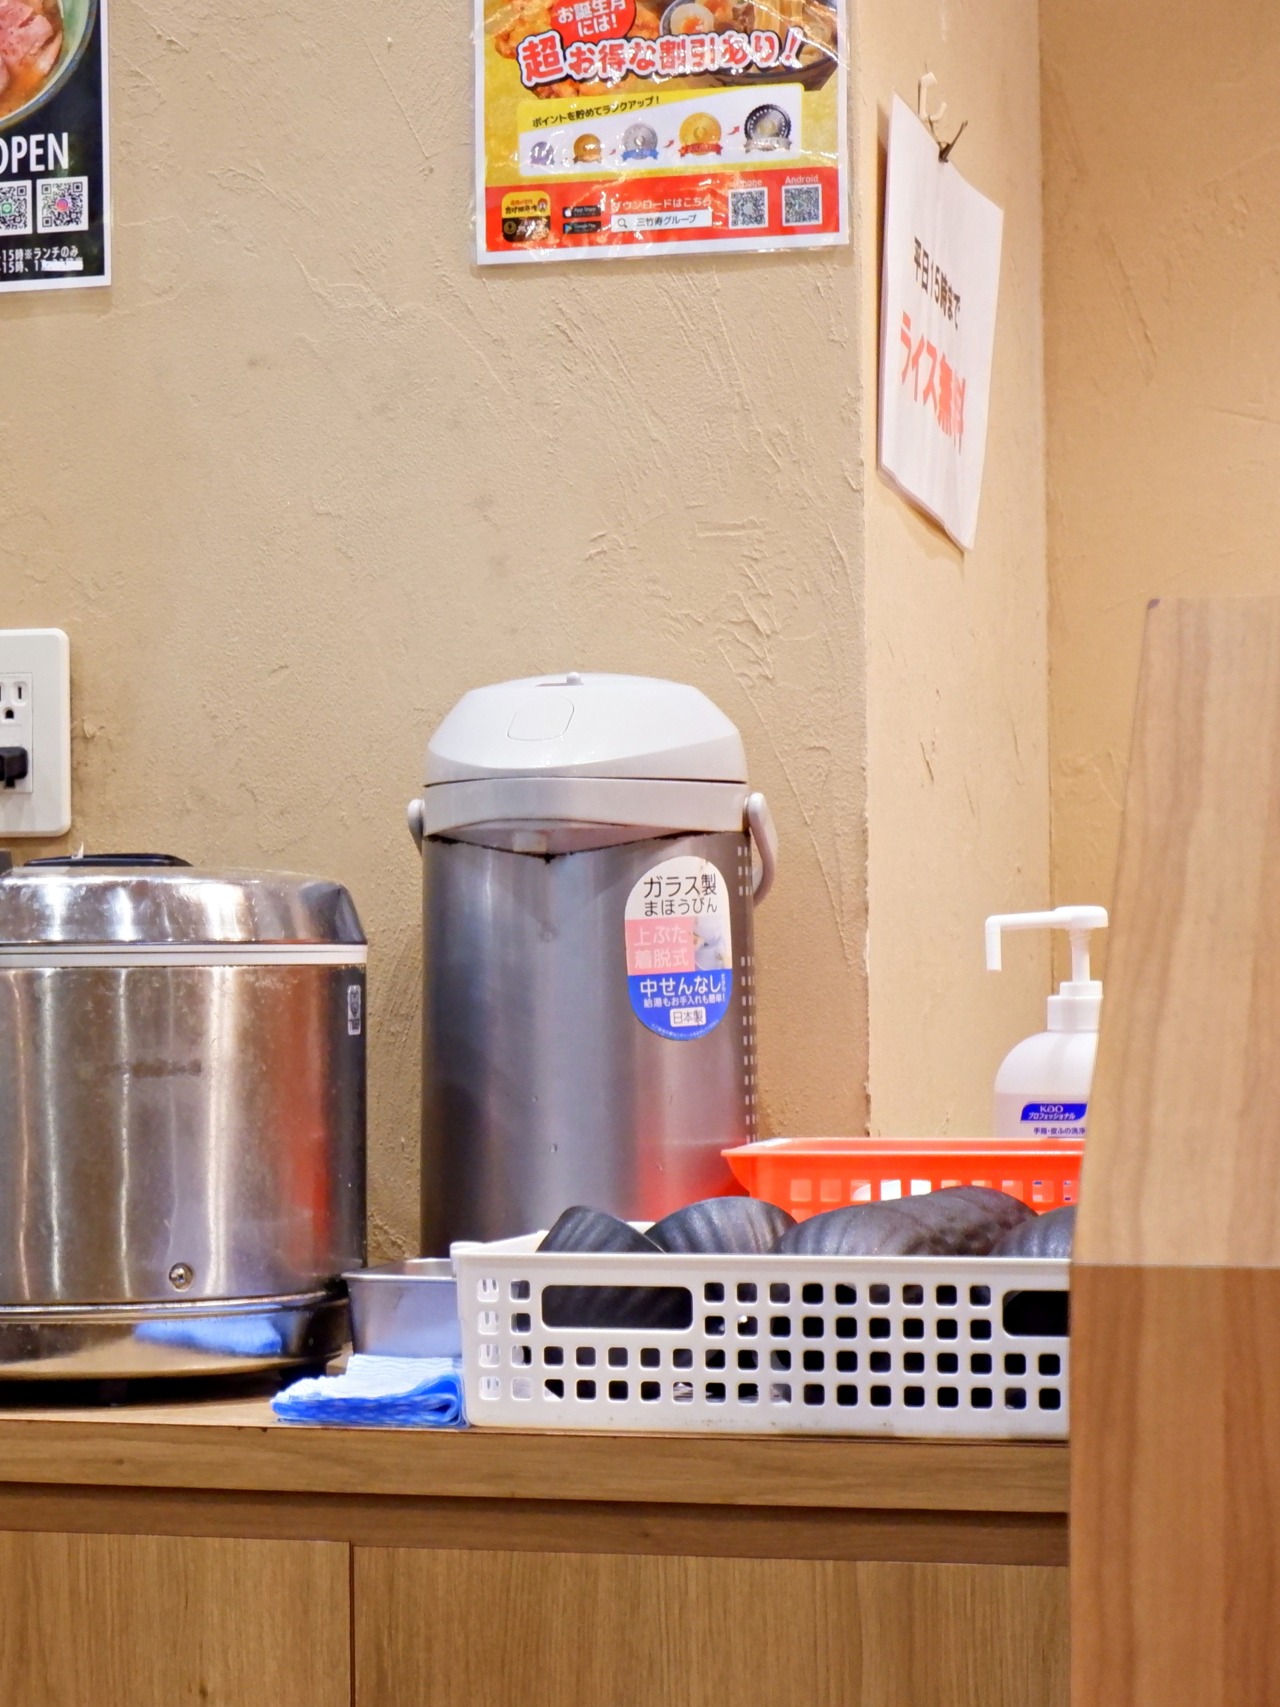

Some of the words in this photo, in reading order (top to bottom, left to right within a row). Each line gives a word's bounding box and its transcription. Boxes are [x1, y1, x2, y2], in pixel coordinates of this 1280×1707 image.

[785, 174, 819, 184] Android
[913, 235, 961, 331] 平日15時まで
[900, 309, 966, 456] ライス無料
[643, 873, 718, 899] ガラス製
[644, 897, 718, 917] まほうびん
[633, 925, 689, 946] 上ぶた
[634, 948, 690, 970] 着脱式
[640, 974, 721, 997] 中せんなし
[672, 1010, 704, 1025] 日本製
[1028, 1112, 1076, 1120] プロフェッショナル
